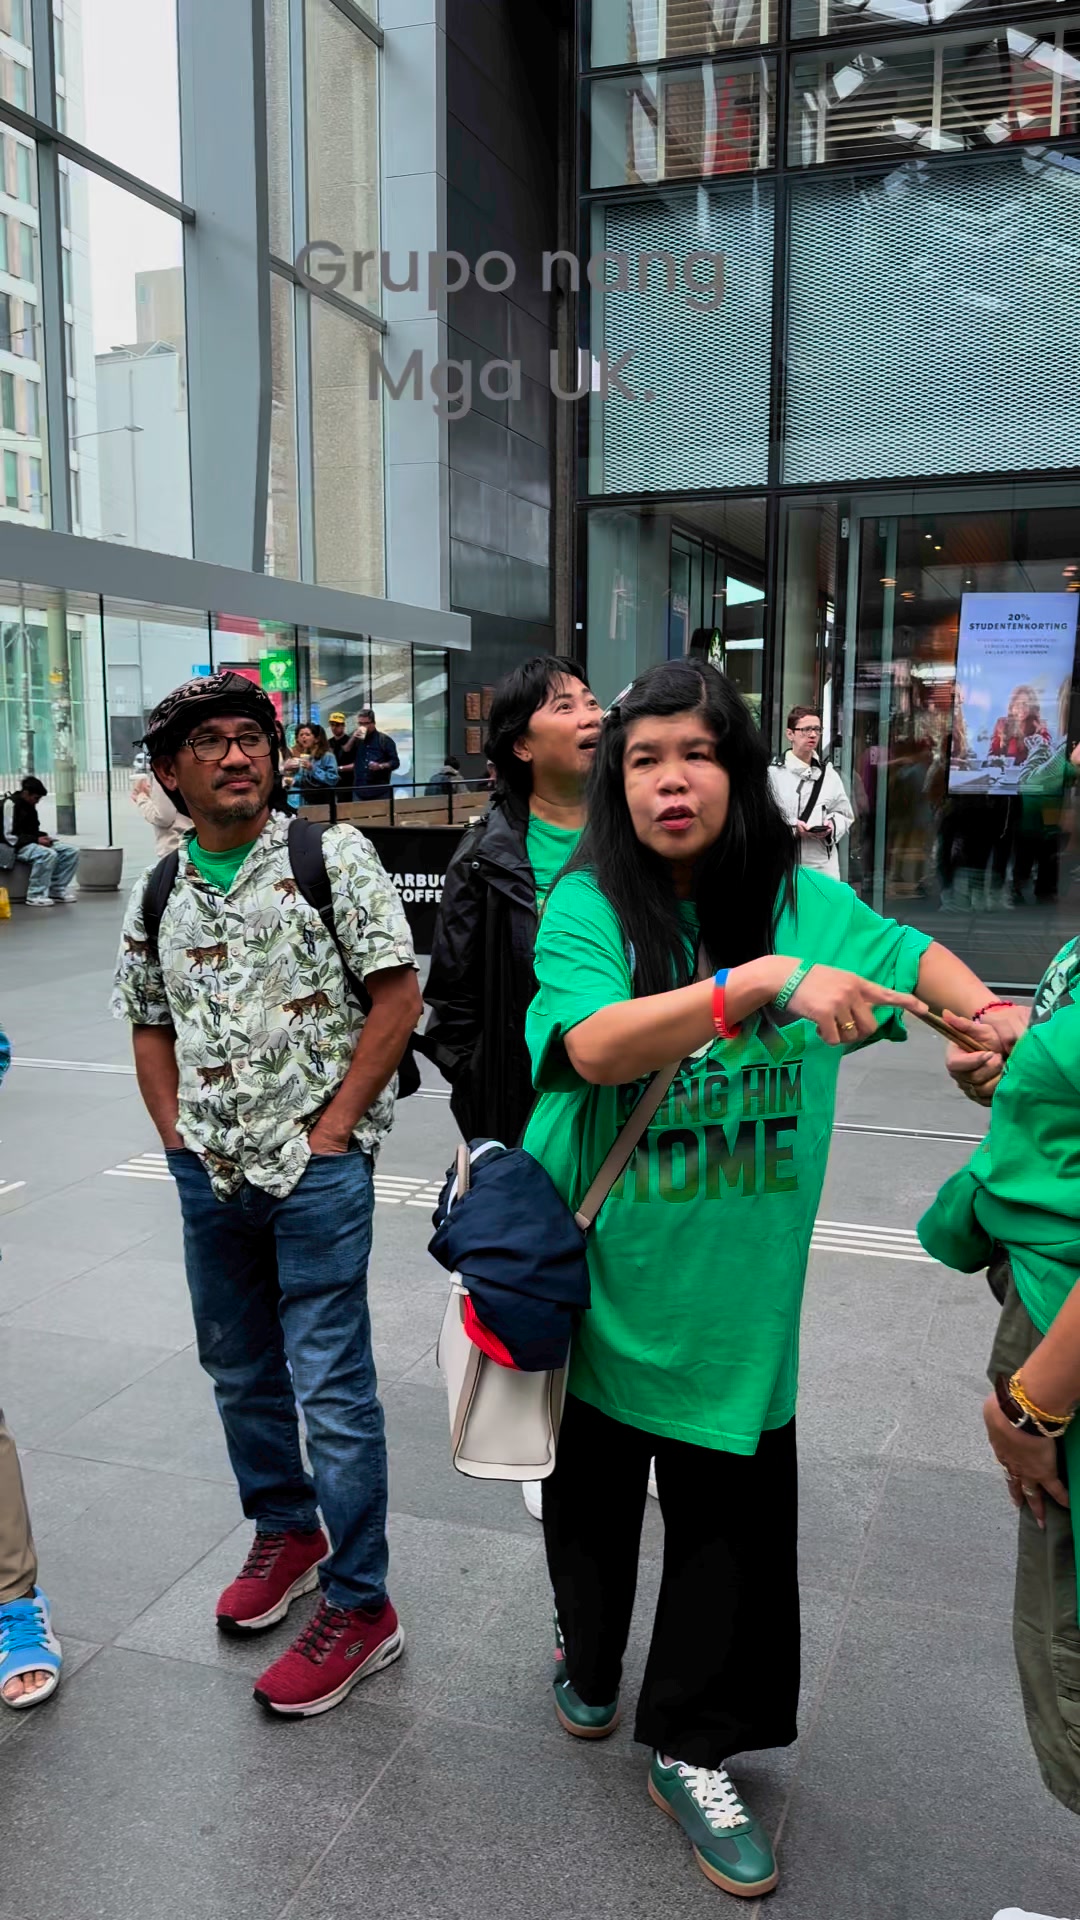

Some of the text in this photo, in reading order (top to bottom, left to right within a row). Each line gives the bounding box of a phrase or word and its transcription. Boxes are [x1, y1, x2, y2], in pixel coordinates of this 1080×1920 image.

[1008, 613, 1030, 621] 20%
[968, 622, 1068, 631] STUDENTENKORTING
[616, 1064, 803, 1126] BING HIM
